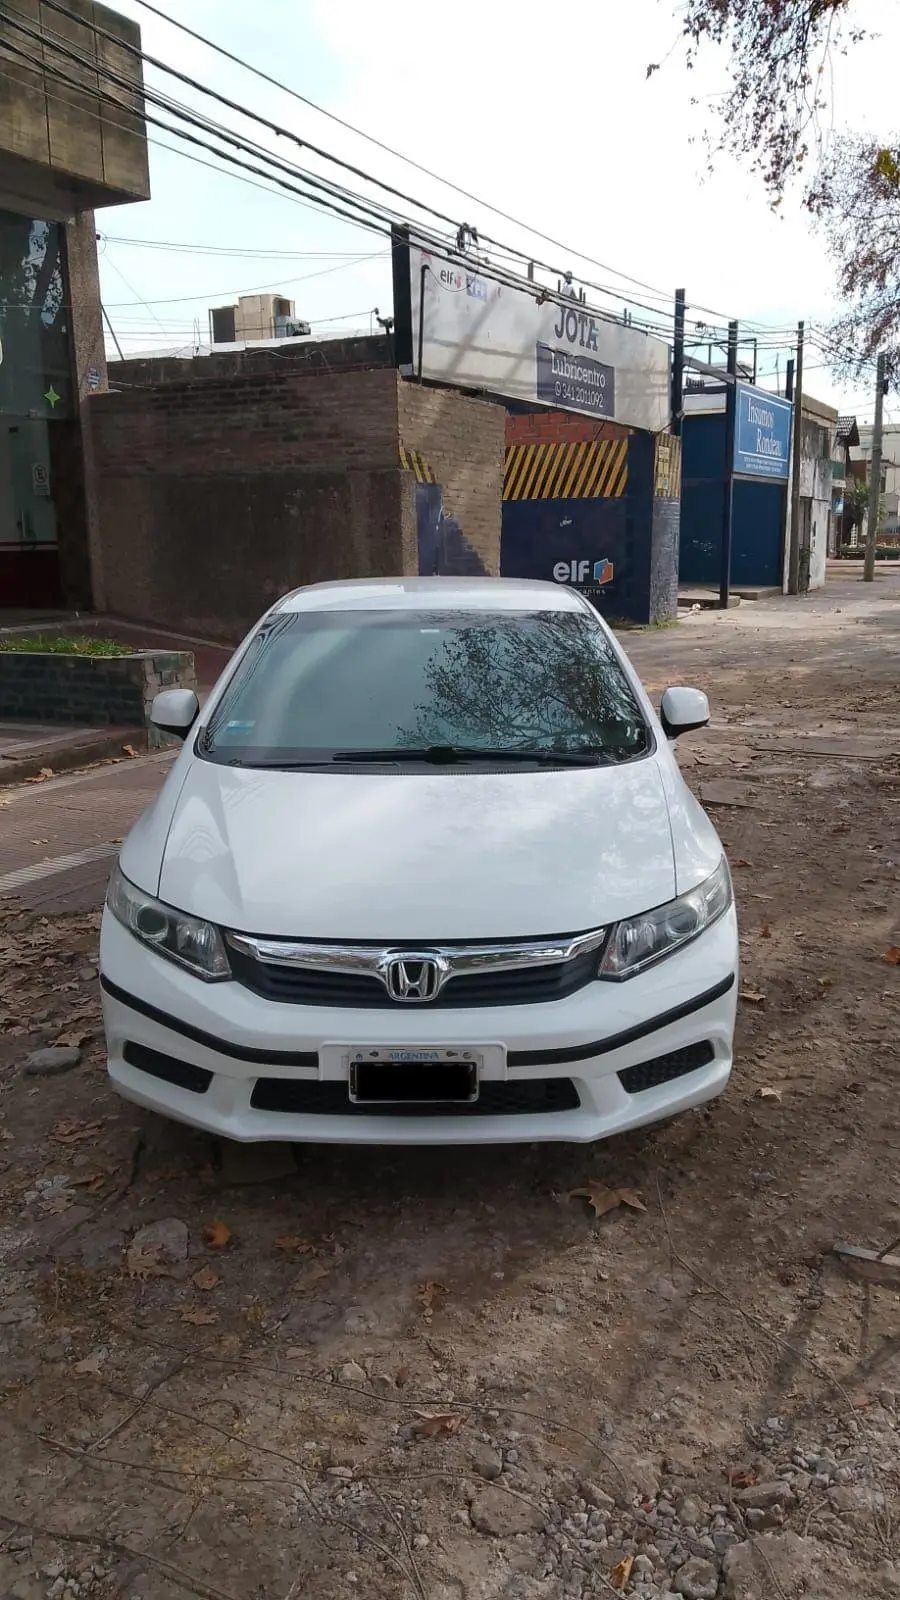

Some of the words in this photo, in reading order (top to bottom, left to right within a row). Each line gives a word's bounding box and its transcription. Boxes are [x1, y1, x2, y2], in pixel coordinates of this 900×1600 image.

[440, 269, 454, 285] elf
[554, 308, 598, 351] JOTA
[551, 353, 606, 388] Lubricentro
[748, 398, 775, 428] Insumos
[756, 428, 782, 456] Rondeau
[553, 560, 590, 582] elf
[388, 1051, 440, 1060] ARGENTINA
